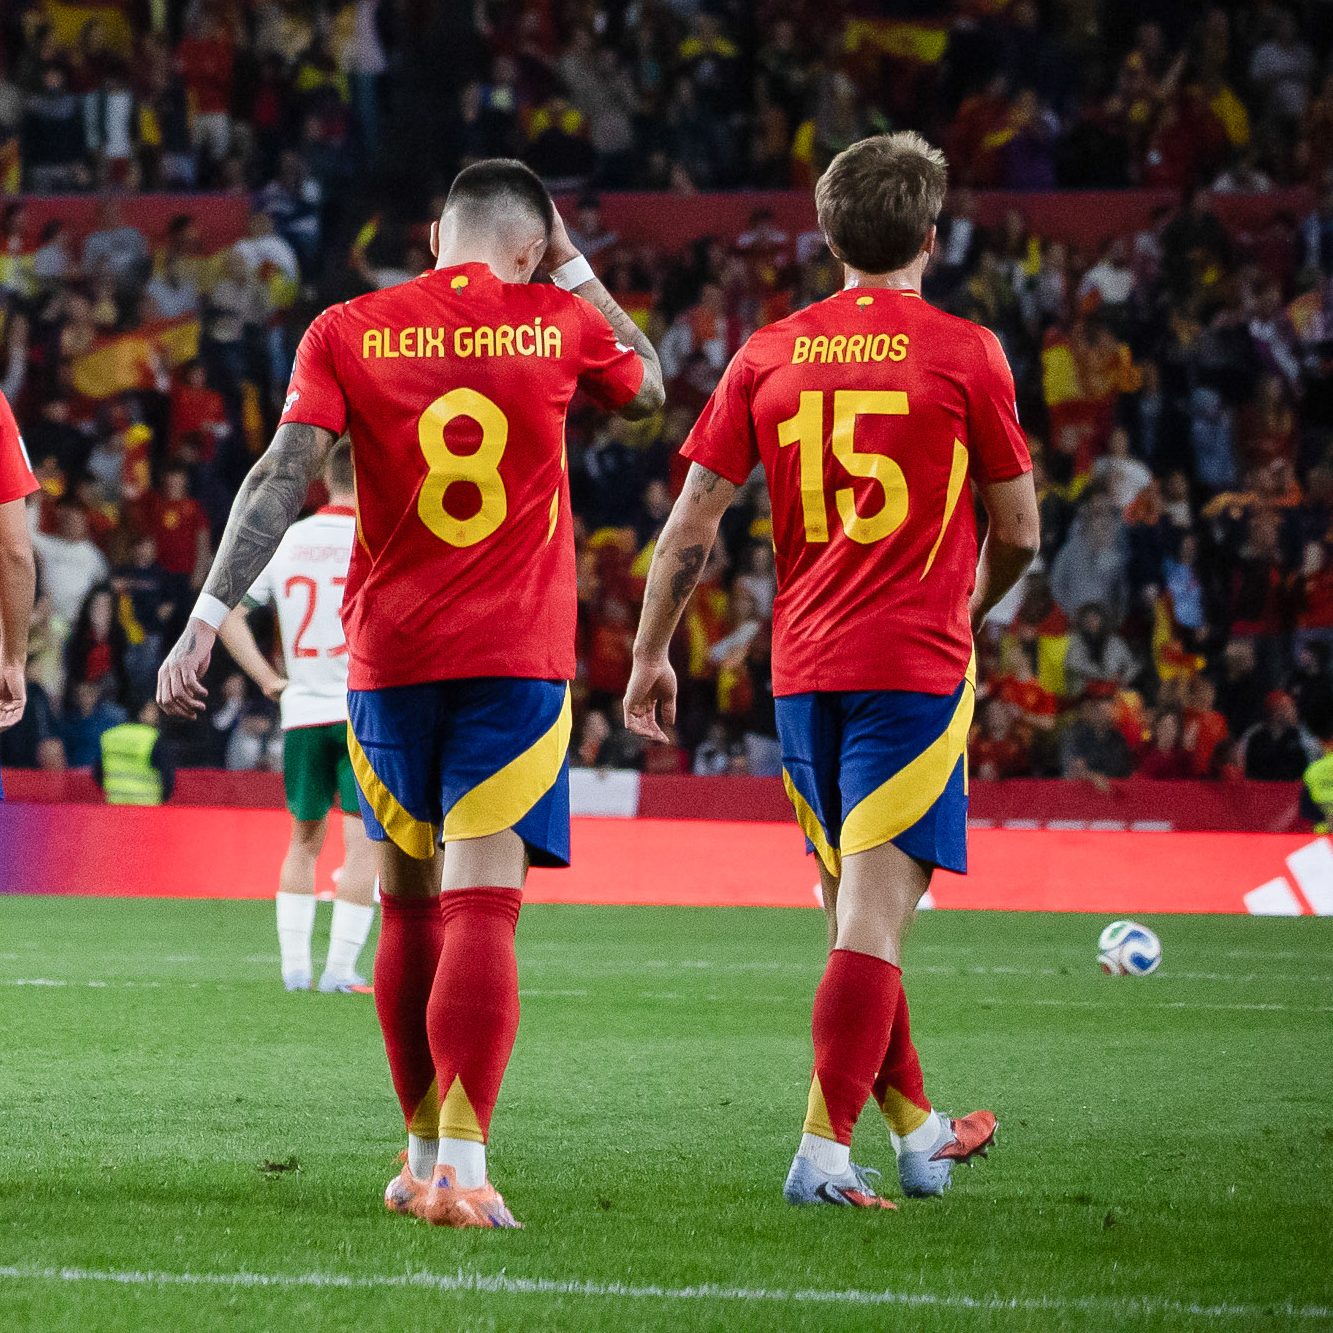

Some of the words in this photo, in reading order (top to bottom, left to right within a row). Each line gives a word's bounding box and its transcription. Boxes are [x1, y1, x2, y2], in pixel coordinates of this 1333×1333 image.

[362, 326, 445, 359] ALEIX
[453, 316, 562, 358] GARCÍA
[791, 333, 910, 364] BARRIOS
[417, 387, 509, 548] 8
[777, 389, 910, 545] 15
